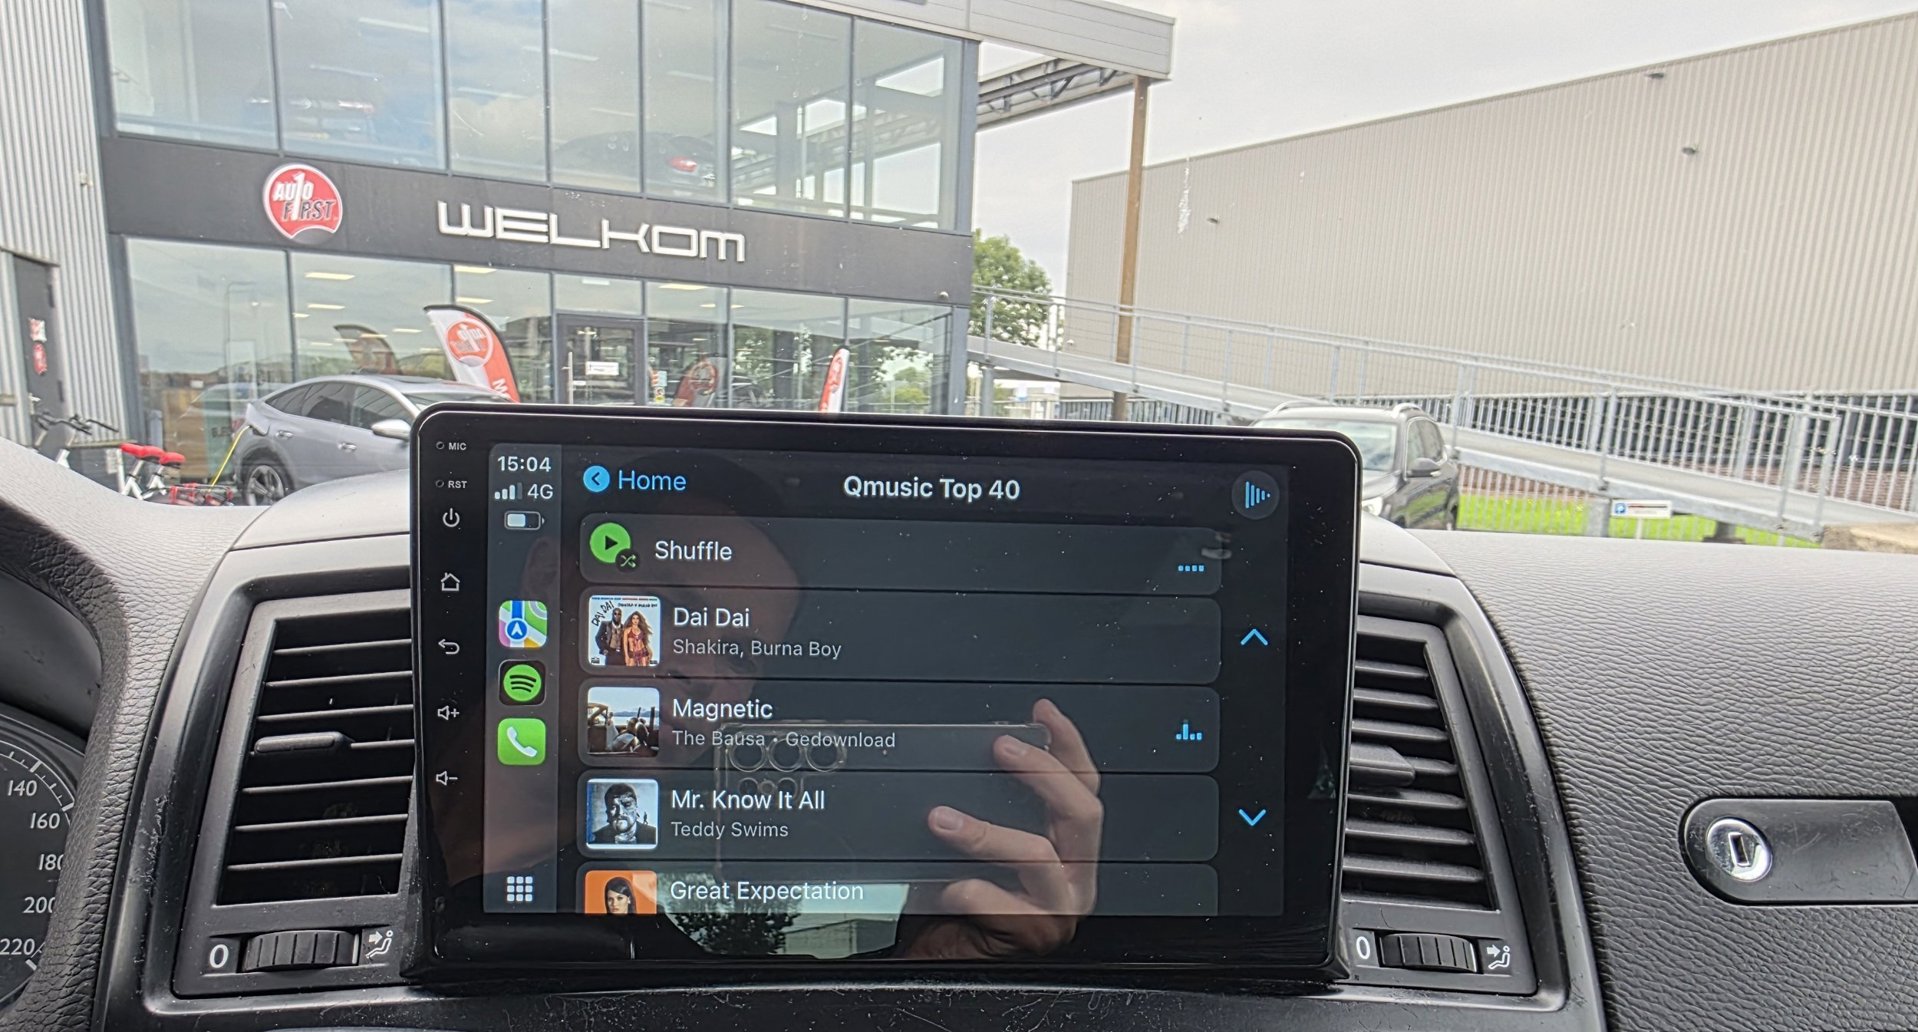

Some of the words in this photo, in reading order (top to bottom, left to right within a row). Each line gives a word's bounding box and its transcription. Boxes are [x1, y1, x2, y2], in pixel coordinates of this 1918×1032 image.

[437, 200, 746, 262] WELKOM
[448, 441, 467, 451] MIC
[497, 456, 551, 473] 15:04
[448, 479, 467, 489] RST
[618, 470, 687, 492] Home
[843, 475, 934, 499] Qmusic
[939, 477, 983, 501] Top
[988, 479, 1020, 500] 40
[527, 484, 554, 500] 4G
[655, 540, 733, 561] Shuffle
[673, 608, 708, 627] Dai
[715, 608, 750, 627] Dai
[673, 638, 744, 658] Shakira,
[750, 640, 803, 657] Burna
[808, 641, 841, 660] Boy
[672, 698, 773, 721] Magnetic
[672, 730, 706, 747] The
[712, 731, 766, 747] Bausa
[785, 732, 896, 748] Gedownload
[7, 780, 38, 796] 140
[671, 790, 705, 809] Mr.
[712, 791, 771, 810] Know
[778, 791, 793, 810] It
[798, 790, 826, 810] All
[30, 813, 61, 829] 160
[671, 821, 726, 840] Teddy
[731, 822, 789, 838] Swims
[670, 882, 730, 901] Great
[736, 882, 864, 905] Expectation
[0, 938, 36, 956] 220
